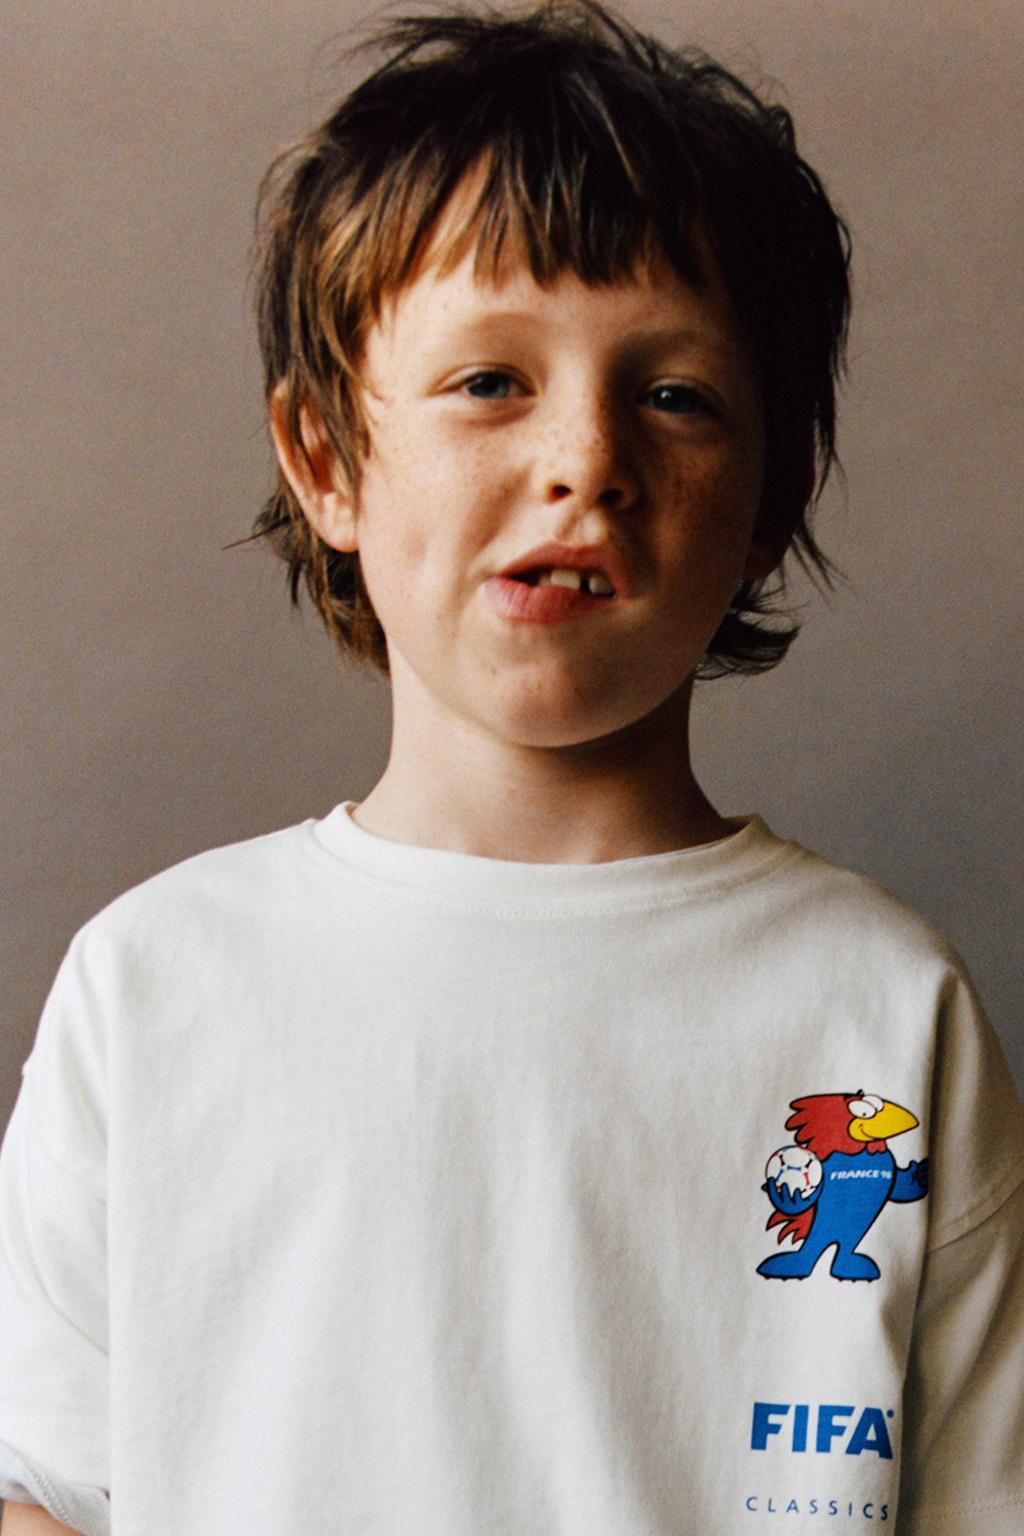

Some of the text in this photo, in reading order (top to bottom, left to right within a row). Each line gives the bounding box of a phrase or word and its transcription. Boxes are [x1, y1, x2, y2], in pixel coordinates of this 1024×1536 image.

[830, 1169, 879, 1180] FRANCE
[751, 1402, 894, 1460] FIFA
[746, 1496, 888, 1520] CLASSICS
